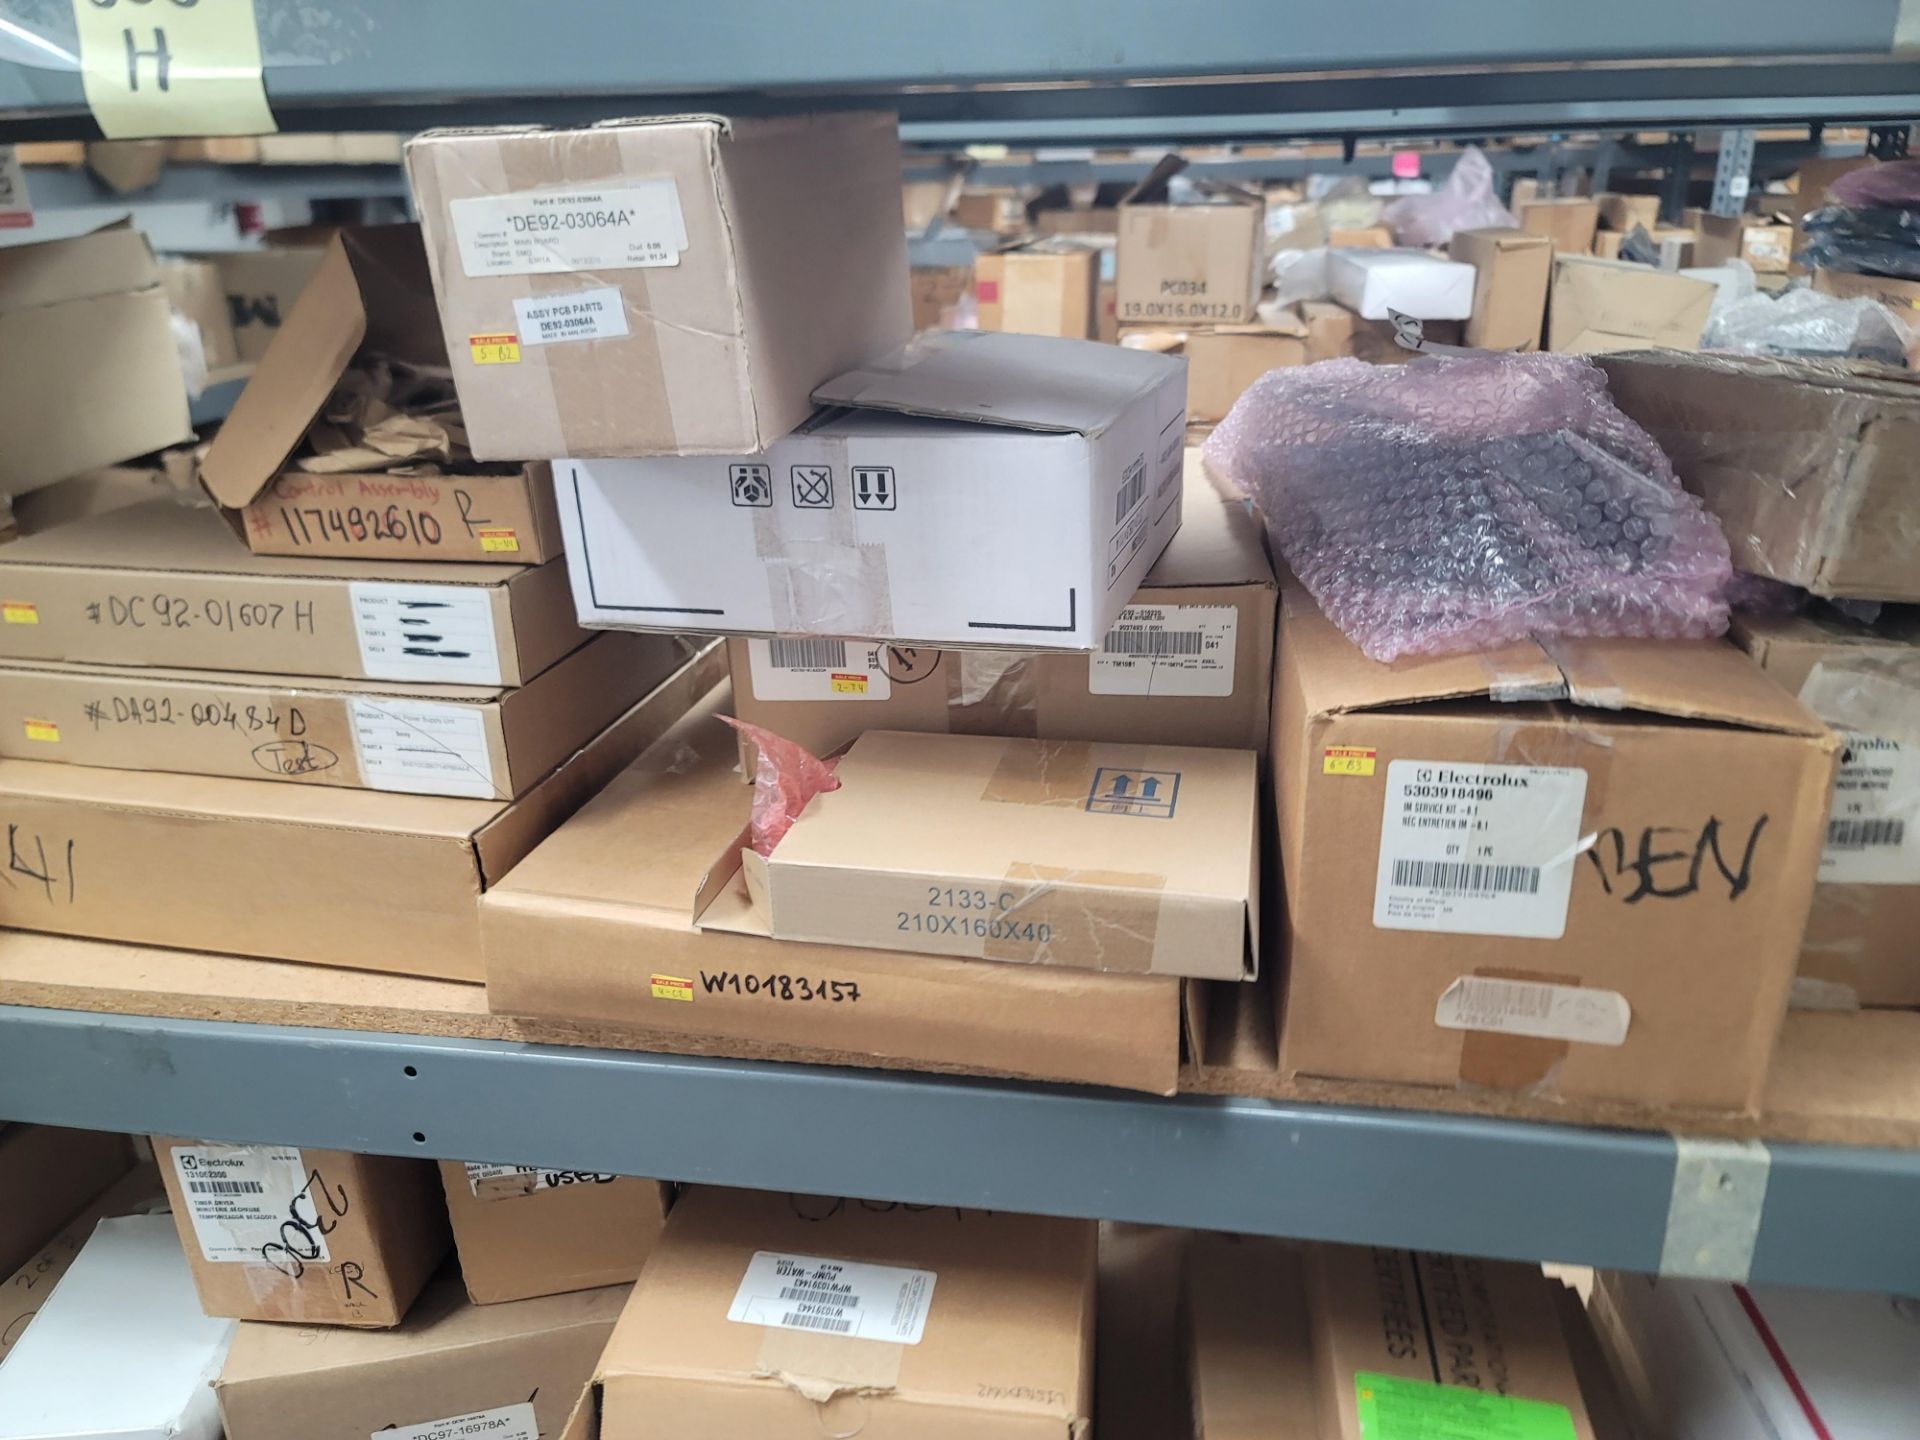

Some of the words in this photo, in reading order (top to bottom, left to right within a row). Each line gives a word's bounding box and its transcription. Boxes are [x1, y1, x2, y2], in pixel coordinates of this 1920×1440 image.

[122, 27, 173, 93] H
[526, 309, 550, 320] ASSY
[552, 306, 572, 316] PCB
[573, 301, 603, 314] PARTS
[359, 480, 441, 505] Assembly
[454, 489, 492, 538] R
[1438, 769, 1529, 788] Electrolux
[1404, 784, 1493, 801] 5303918496
[1414, 803, 1443, 814] SERVICE
[1446, 804, 1457, 815] KIT
[1446, 844, 1460, 855] QTY
[1587, 814, 1769, 904] BEN
[897, 912, 1052, 943] 210X160X40
[700, 970, 861, 1002] W10183157
[198, 1157, 245, 1168] Electrolux
[341, 1261, 378, 1299] R
[794, 1279, 852, 1293] WPW10391443
[797, 1303, 843, 1317] W10391443
[1445, 1340, 1481, 1389] PAR
